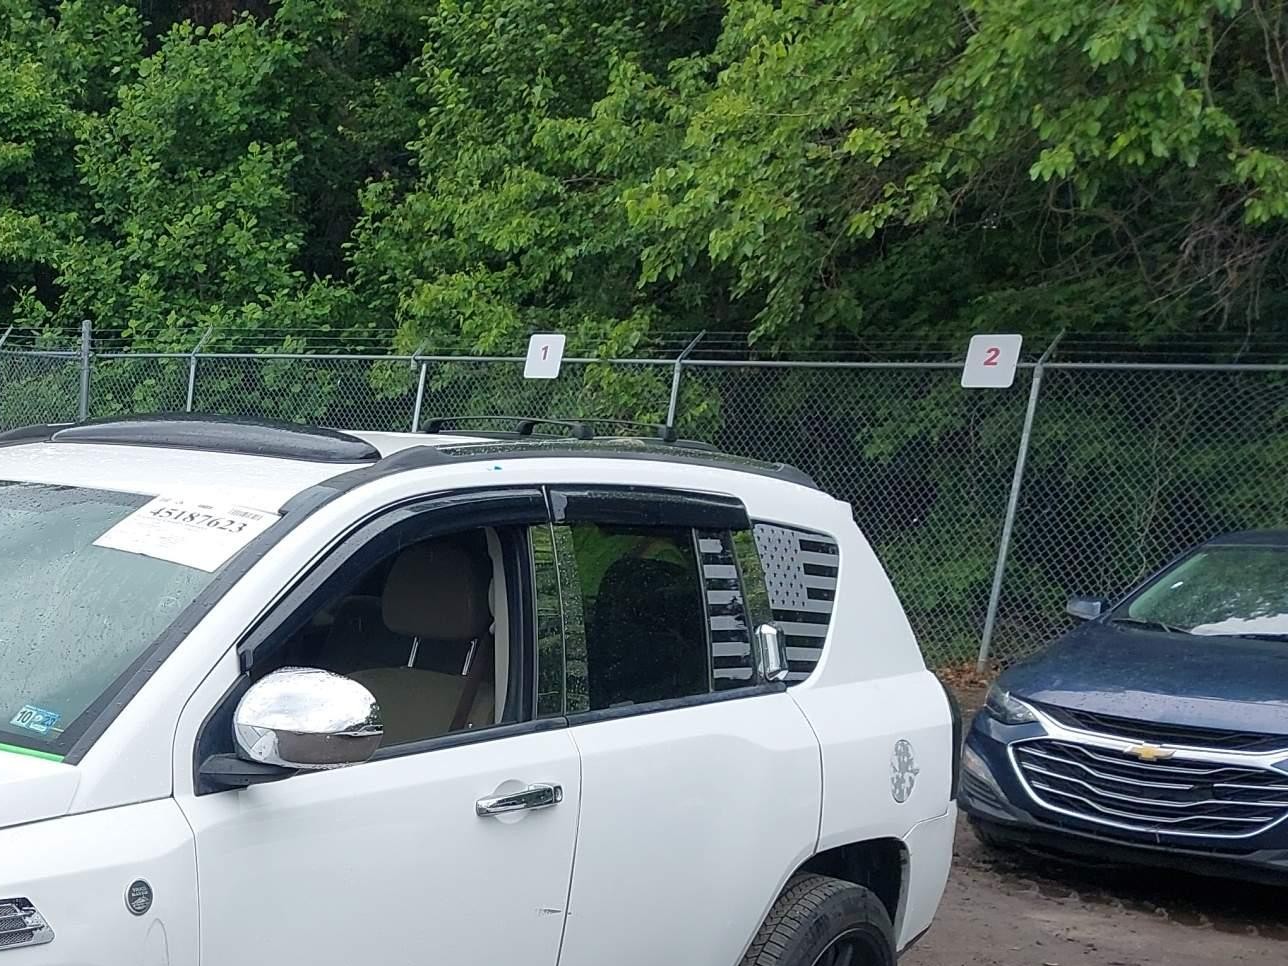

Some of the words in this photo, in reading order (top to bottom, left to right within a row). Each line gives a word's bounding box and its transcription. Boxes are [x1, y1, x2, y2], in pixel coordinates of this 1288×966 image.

[541, 345, 549, 360] 1
[983, 347, 1001, 366] 2
[149, 506, 248, 533] 45187623
[16, 710, 33, 723] 10
